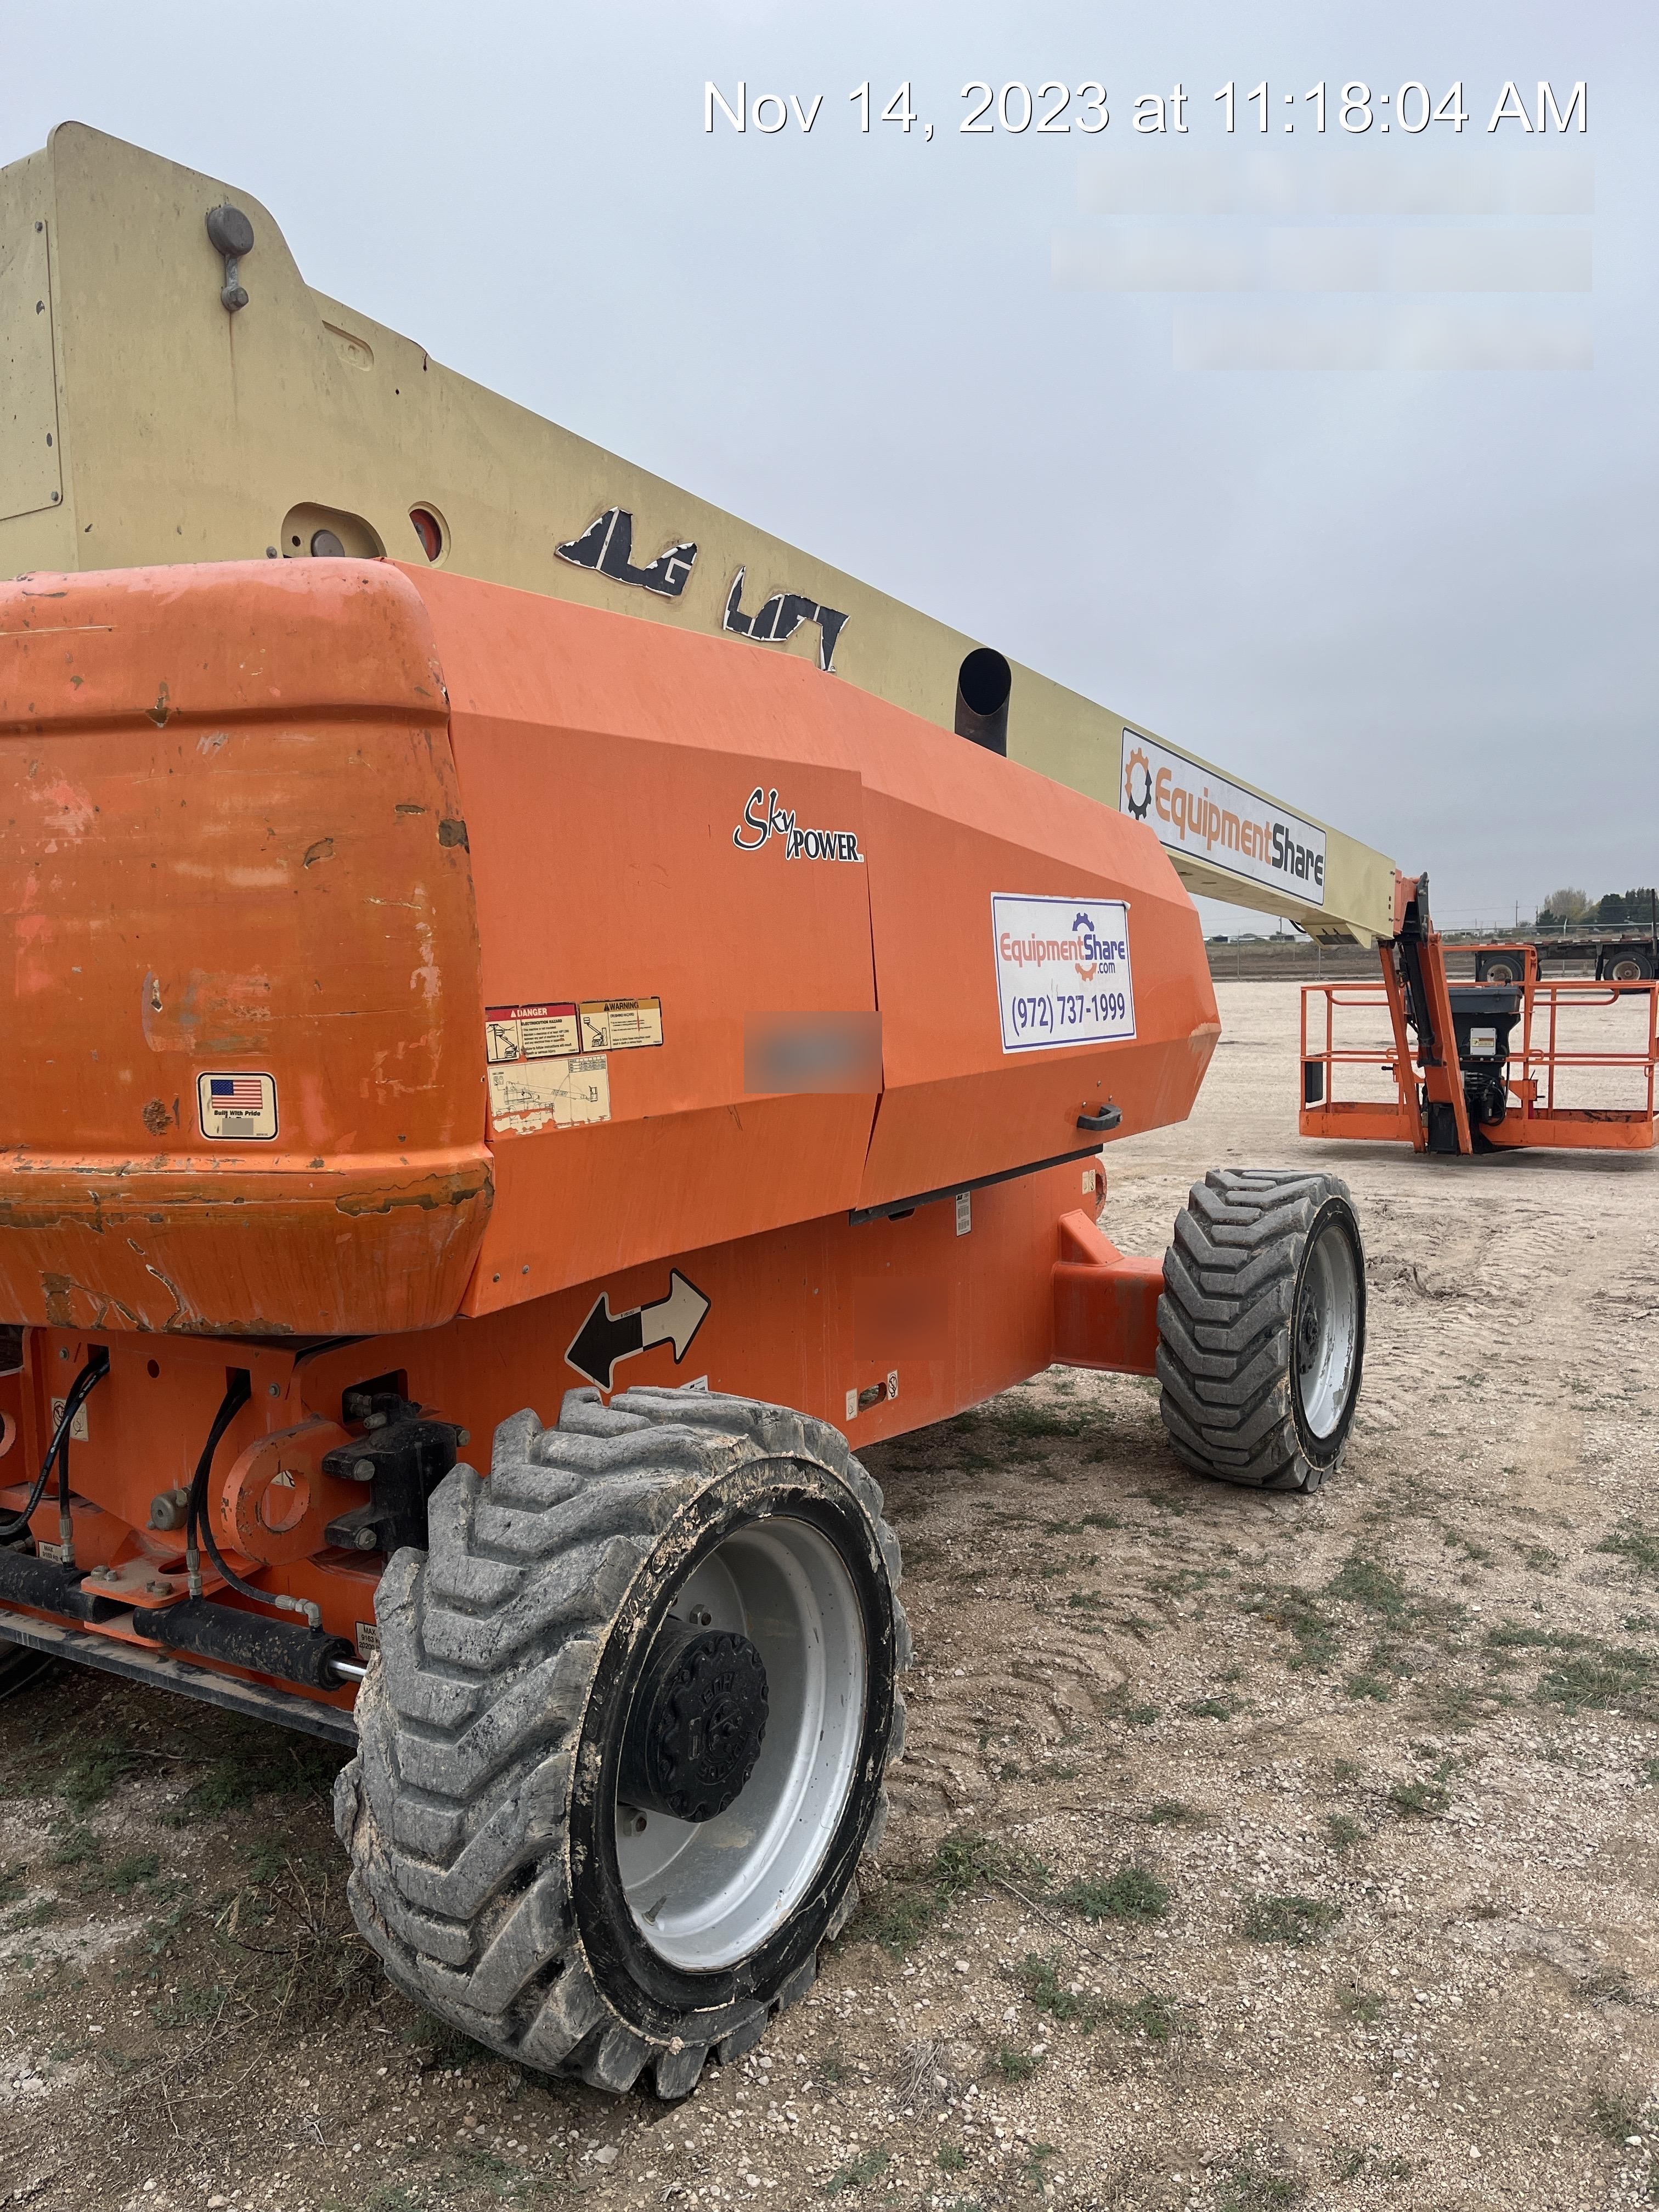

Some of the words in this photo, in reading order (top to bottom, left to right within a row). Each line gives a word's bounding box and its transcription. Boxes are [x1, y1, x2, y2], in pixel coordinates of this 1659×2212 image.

[733, 787, 795, 860] Sky
[1155, 767, 1324, 886] EquipmentShare
[793, 829, 859, 861] POWER
[1000, 933, 1125, 967] EquipmentShare
[1098, 962, 1115, 974] .com
[610, 1002, 639, 1010] WARNING
[516, 1008, 548, 1017] DANGER
[1012, 994, 1053, 1037] (972)
[1057, 992, 1125, 1024] 737-1999
[364, 1626, 376, 1635] MAX
[361, 1634, 374, 1643] 9163
[359, 1642, 375, 1650] 20200
